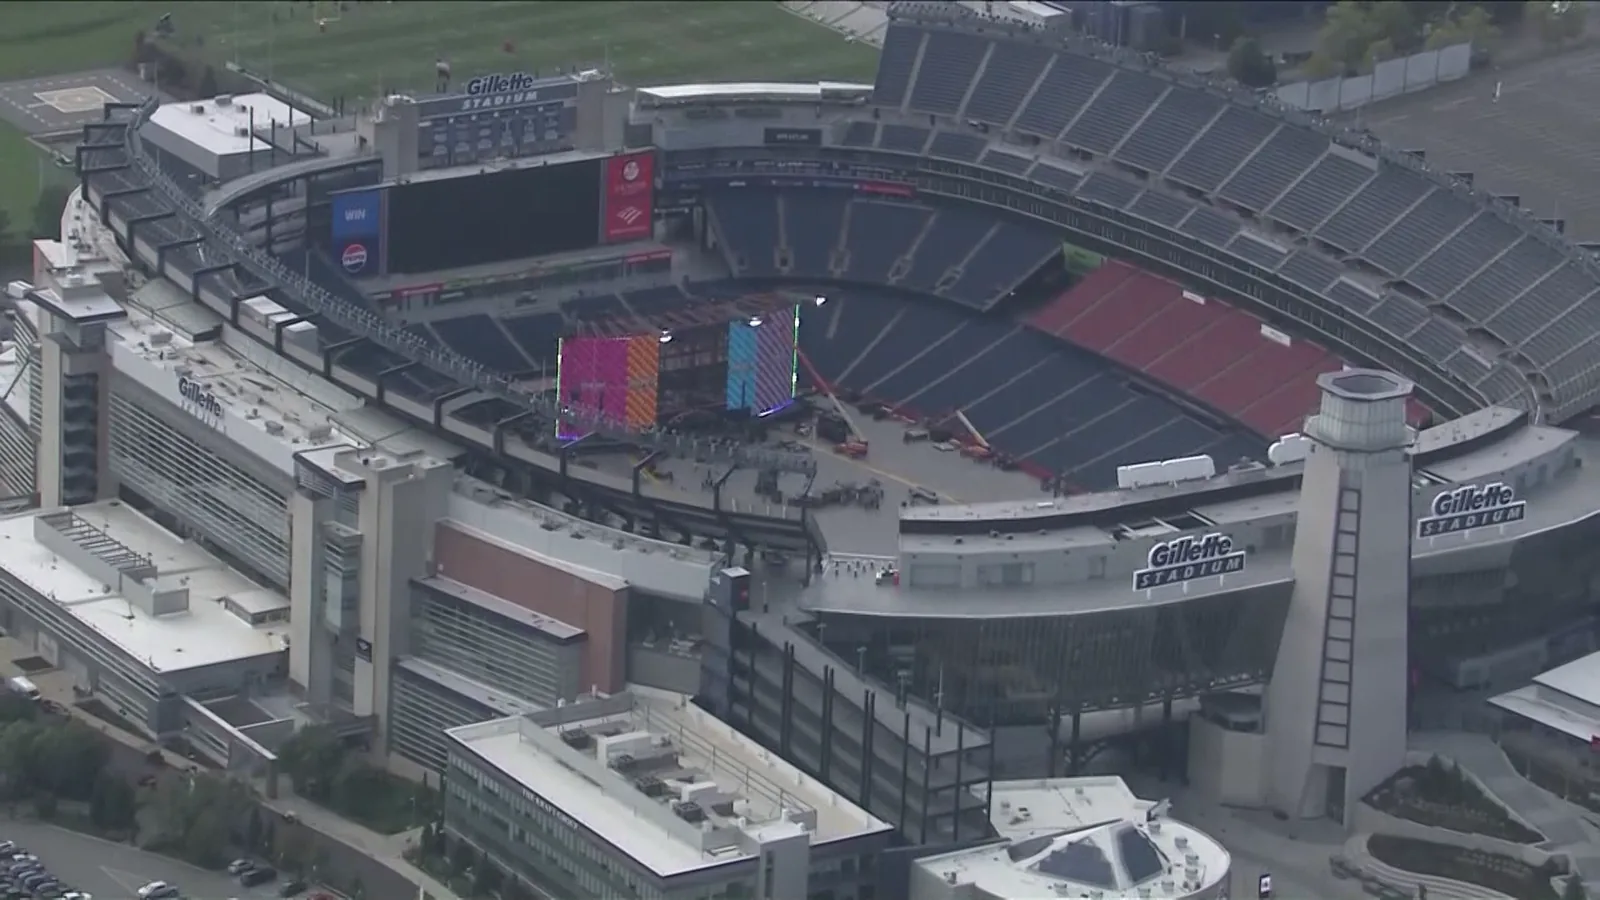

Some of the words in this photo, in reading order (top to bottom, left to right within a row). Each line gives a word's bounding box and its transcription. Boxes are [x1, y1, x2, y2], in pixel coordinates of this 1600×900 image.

[467, 73, 533, 95] Gillette
[461, 91, 538, 110] STADIUM
[345, 208, 366, 221] WIN
[179, 376, 221, 417] Gillette
[1433, 484, 1513, 516] Gillette
[1423, 506, 1521, 534] STADIUM
[1149, 534, 1232, 568] Gillette
[1140, 557, 1241, 587] STADIUM
